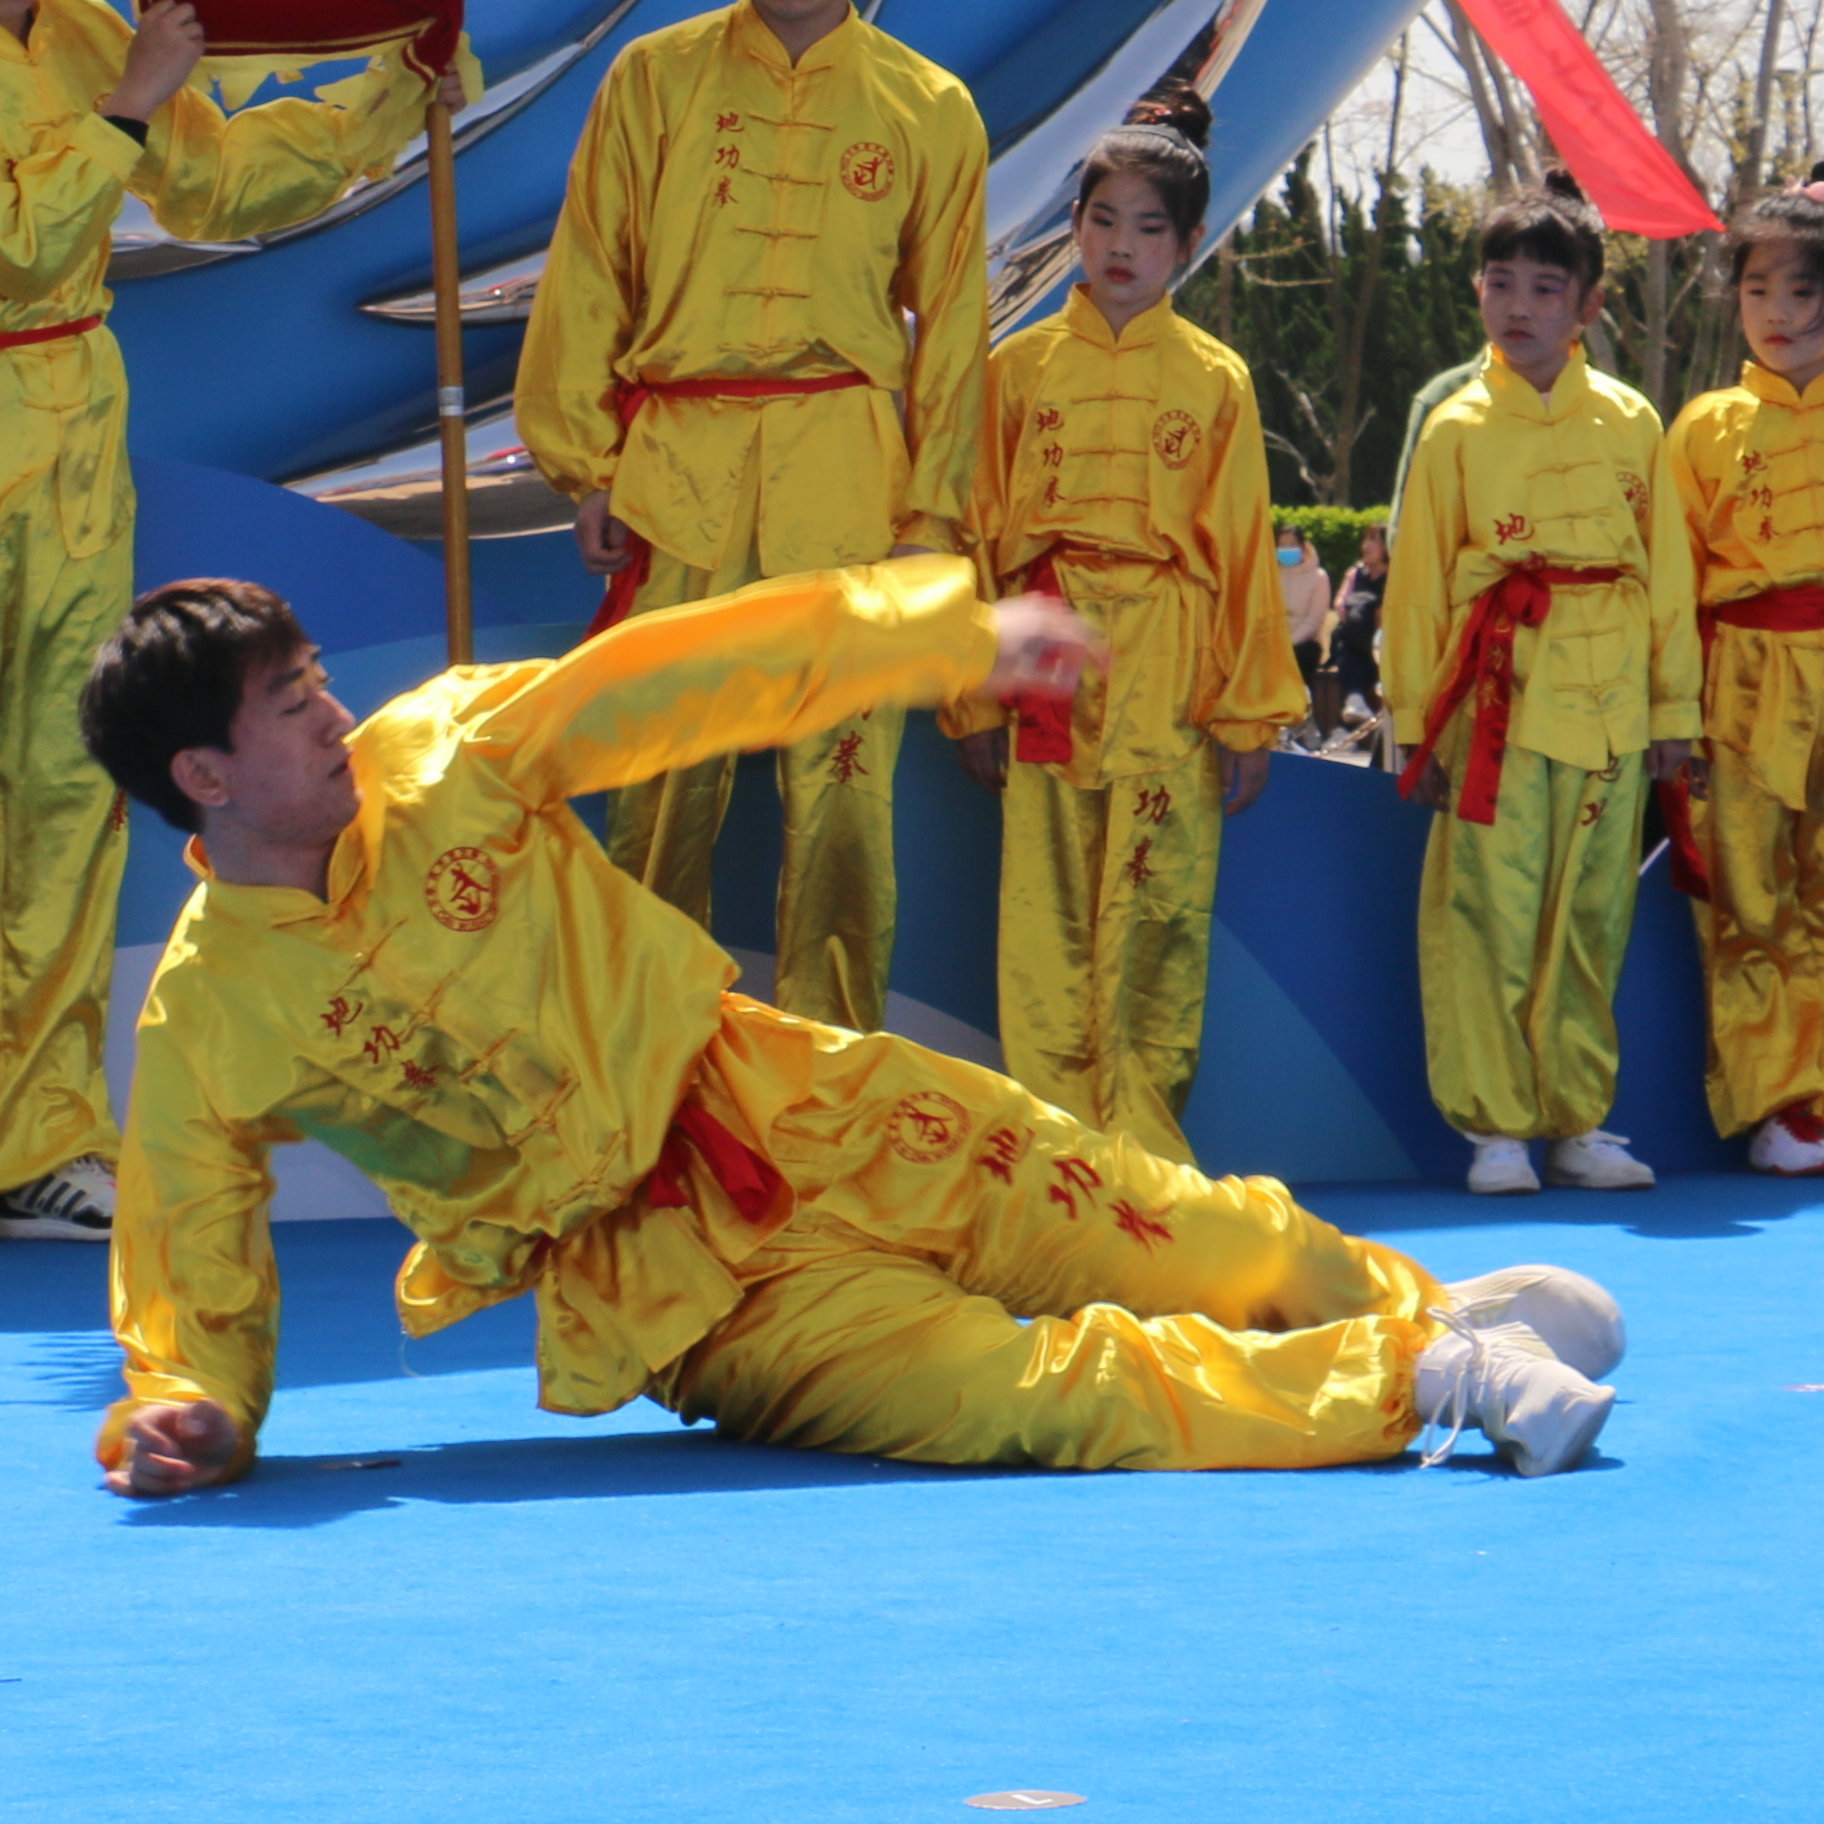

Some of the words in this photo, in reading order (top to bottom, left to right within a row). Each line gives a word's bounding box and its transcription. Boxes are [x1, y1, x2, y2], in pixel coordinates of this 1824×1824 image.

[714, 111, 745, 209] 地功拳
[1035, 407, 1067, 508] 地功拳
[1742, 449, 1780, 543] 地功拳
[1124, 783, 1172, 890] 功拳
[319, 996, 440, 1088] 地功拳
